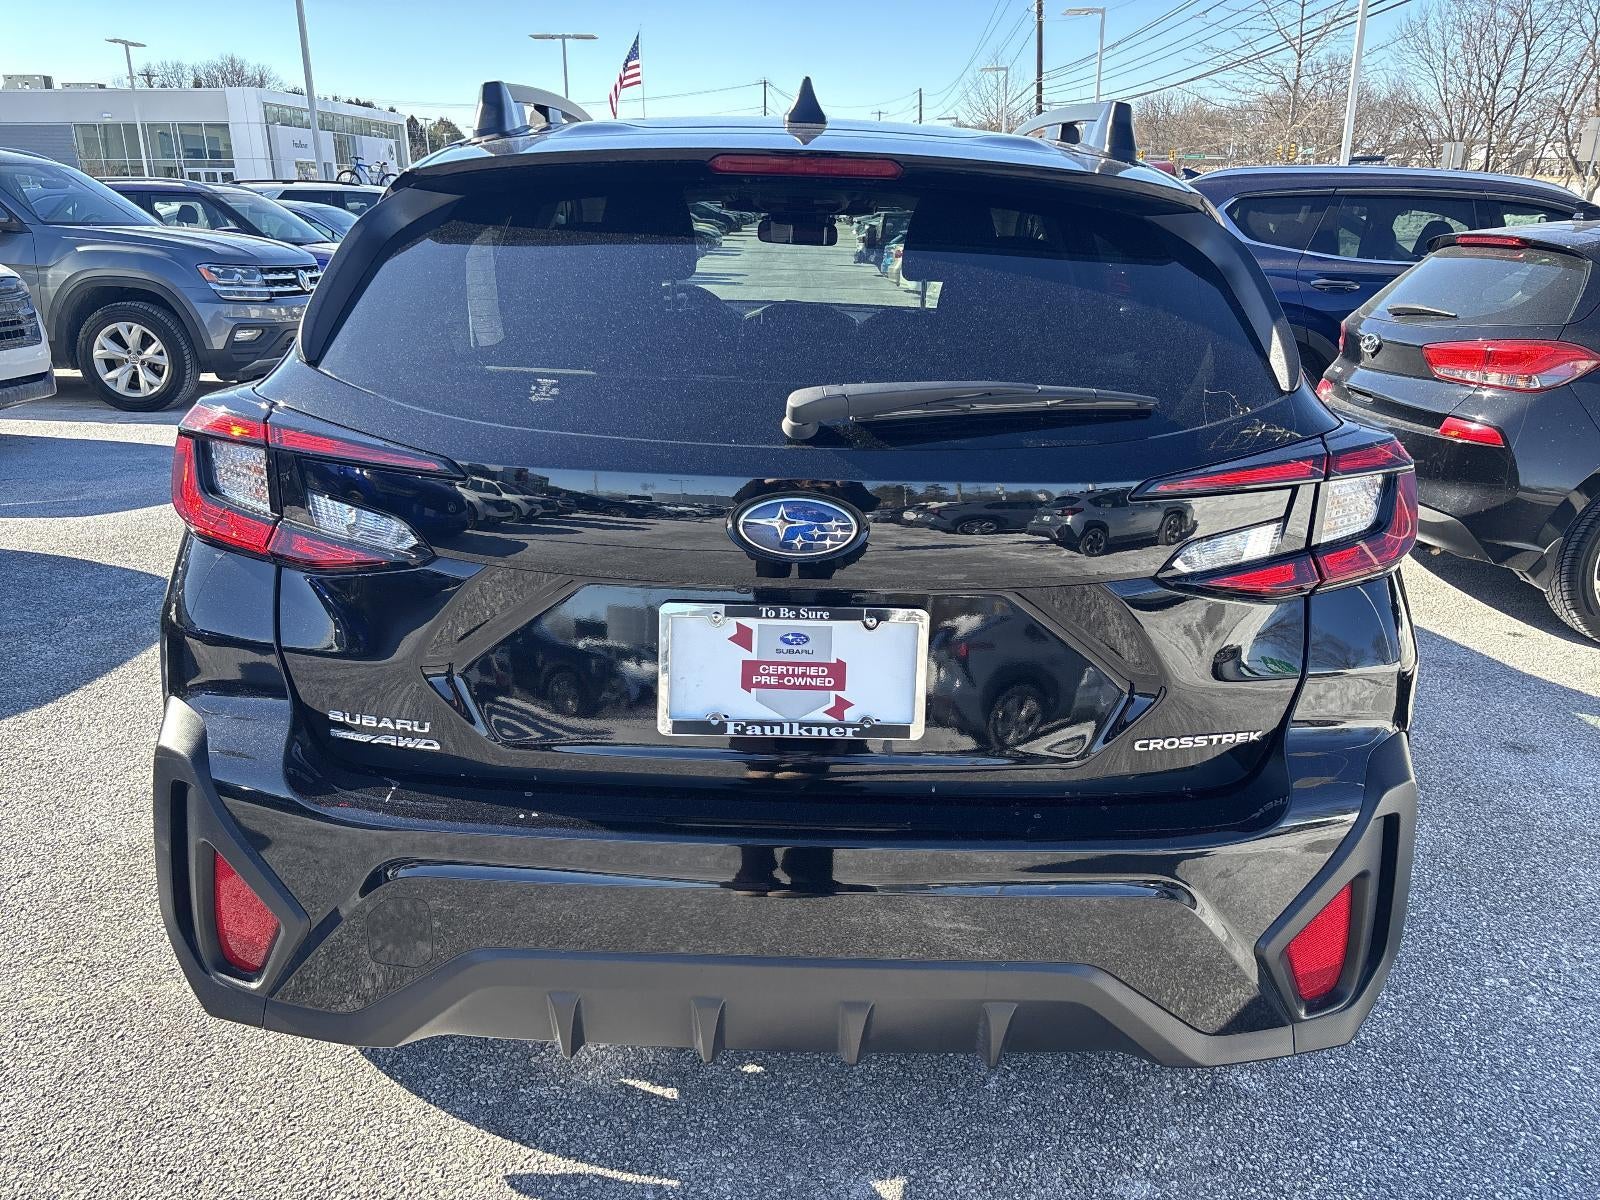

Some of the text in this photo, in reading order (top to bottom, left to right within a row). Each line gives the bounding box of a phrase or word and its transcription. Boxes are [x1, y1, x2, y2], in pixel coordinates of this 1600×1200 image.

[758, 607, 830, 619] To Be Sure
[759, 664, 829, 676] CERTIFIED
[752, 675, 835, 687] PRE-OWNED
[327, 709, 431, 733] SUBARU
[723, 721, 860, 737] Faulkner
[370, 734, 441, 750] AWD
[1133, 730, 1263, 751] CROSSTREK
